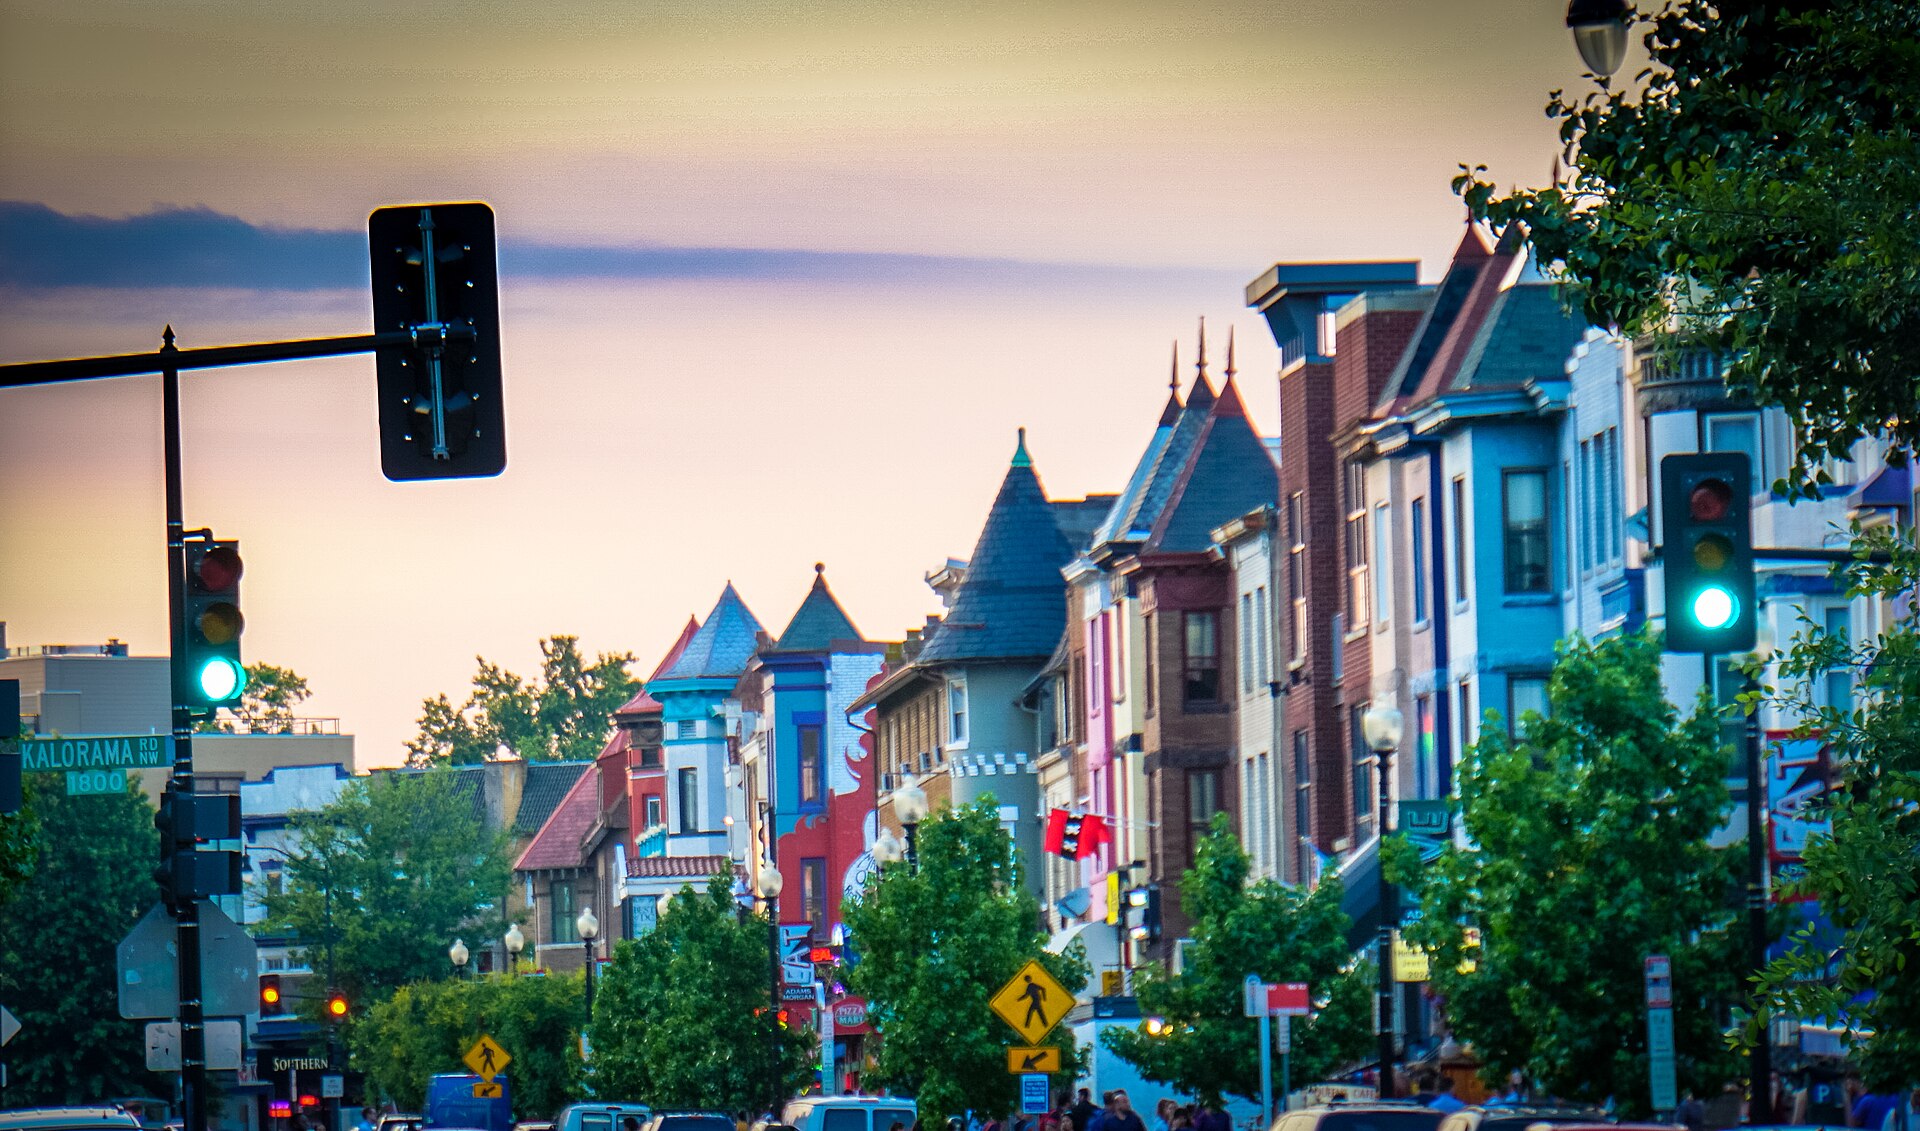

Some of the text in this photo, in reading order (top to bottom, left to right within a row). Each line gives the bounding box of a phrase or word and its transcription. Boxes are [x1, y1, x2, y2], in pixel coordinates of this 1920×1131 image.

[21, 737, 158, 769] KALORAMA RD
[139, 751, 159, 765] NW
[69, 772, 123, 793] 1800
[781, 928, 815, 987] EAT
[839, 1006, 864, 1015] PIZZA
[839, 1015, 864, 1024] MART
[273, 1057, 328, 1072] SOUTHERN
